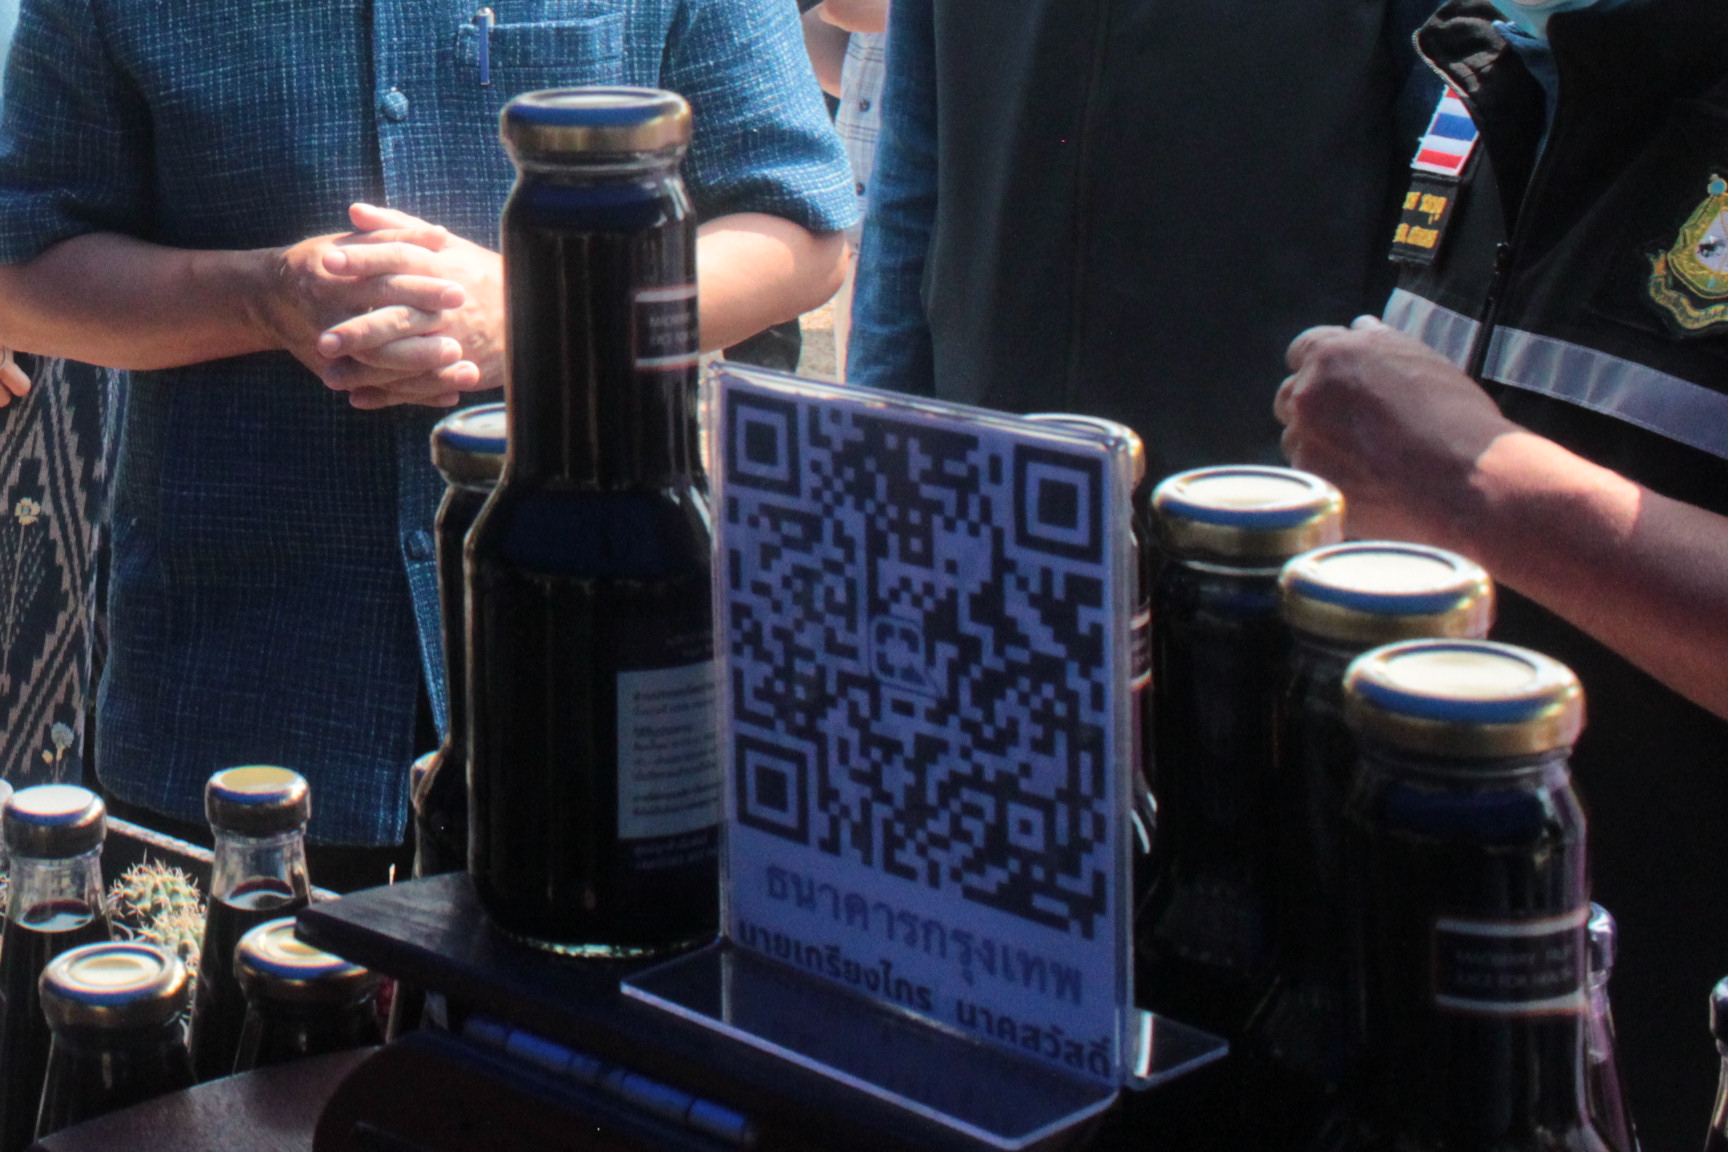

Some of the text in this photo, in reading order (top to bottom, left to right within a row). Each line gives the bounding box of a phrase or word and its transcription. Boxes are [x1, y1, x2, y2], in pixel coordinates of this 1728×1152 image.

[738, 918, 1113, 1079] นายเกรียงไกร นาคสวัสดิ์
[765, 862, 1084, 1006] ธนาคารกรุงเทพ
